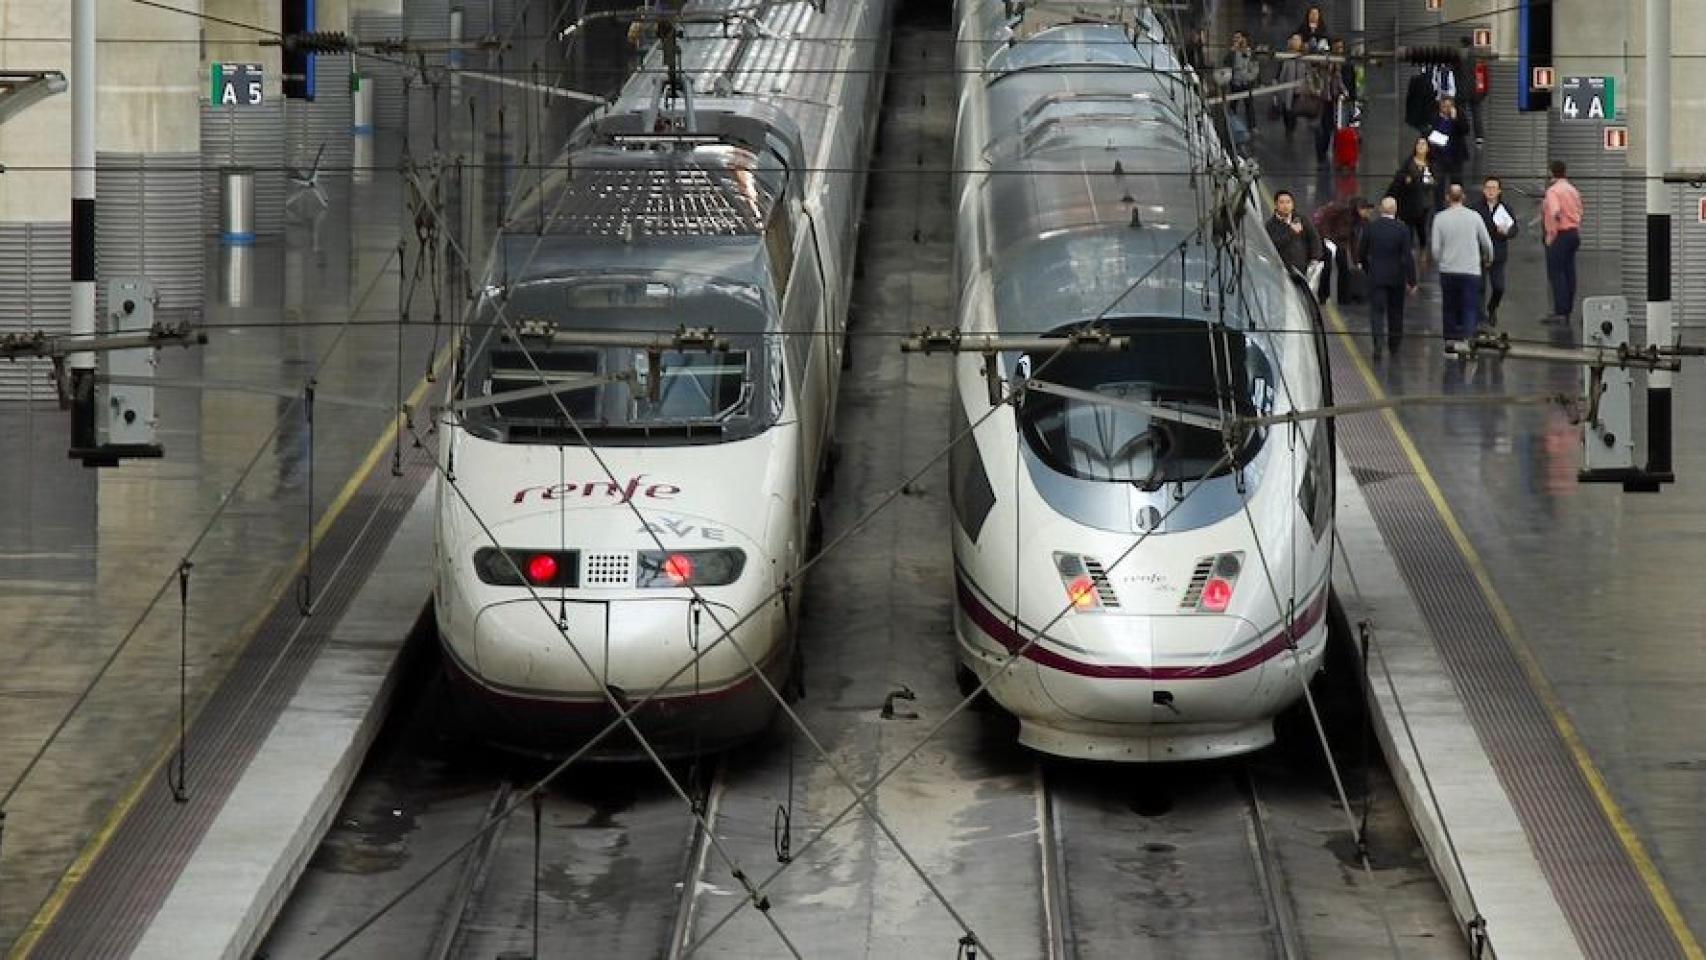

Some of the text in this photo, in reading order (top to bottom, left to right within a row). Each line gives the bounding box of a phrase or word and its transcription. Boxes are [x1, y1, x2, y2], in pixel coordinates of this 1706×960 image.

[222, 82, 262, 105] A 5
[1563, 95, 1605, 118] 4 A
[514, 474, 681, 505] renfe
